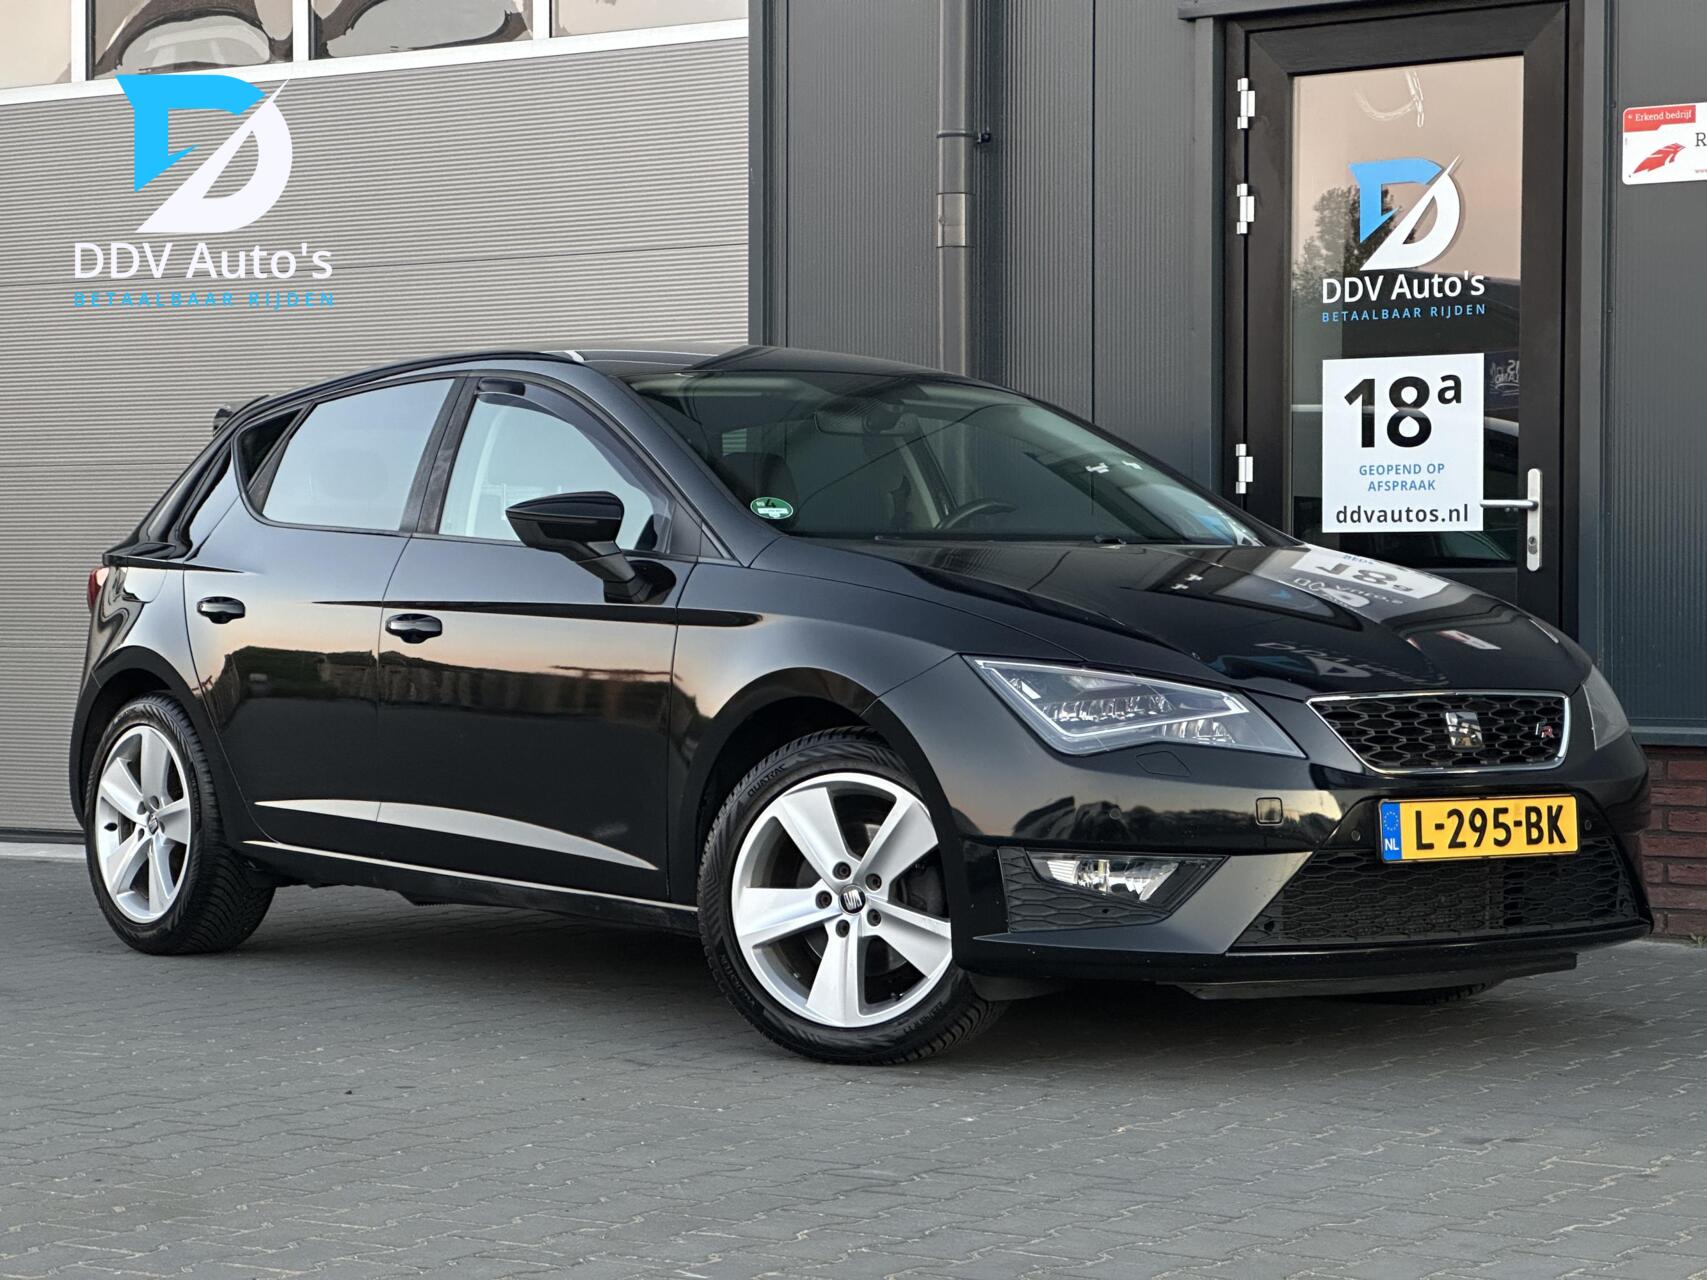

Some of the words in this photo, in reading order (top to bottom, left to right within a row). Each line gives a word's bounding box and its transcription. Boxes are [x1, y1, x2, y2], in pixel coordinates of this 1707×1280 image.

[1635, 112, 1664, 121] Erkend
[1665, 110, 1692, 120] bedrijf
[1322, 275, 1384, 304] DDV
[1390, 270, 1486, 300] Auto's
[1322, 307, 1422, 322] BETAALBAAR
[1430, 303, 1486, 319] RIJDEN
[1359, 464, 1422, 476] GEOPEND
[1426, 463, 1445, 475] OP
[1367, 479, 1436, 492] AFSPRAAK
[1336, 503, 1468, 523] ddvautos.nl
[1384, 837, 1400, 851] NL
[1415, 804, 1567, 851] L-295-BK
